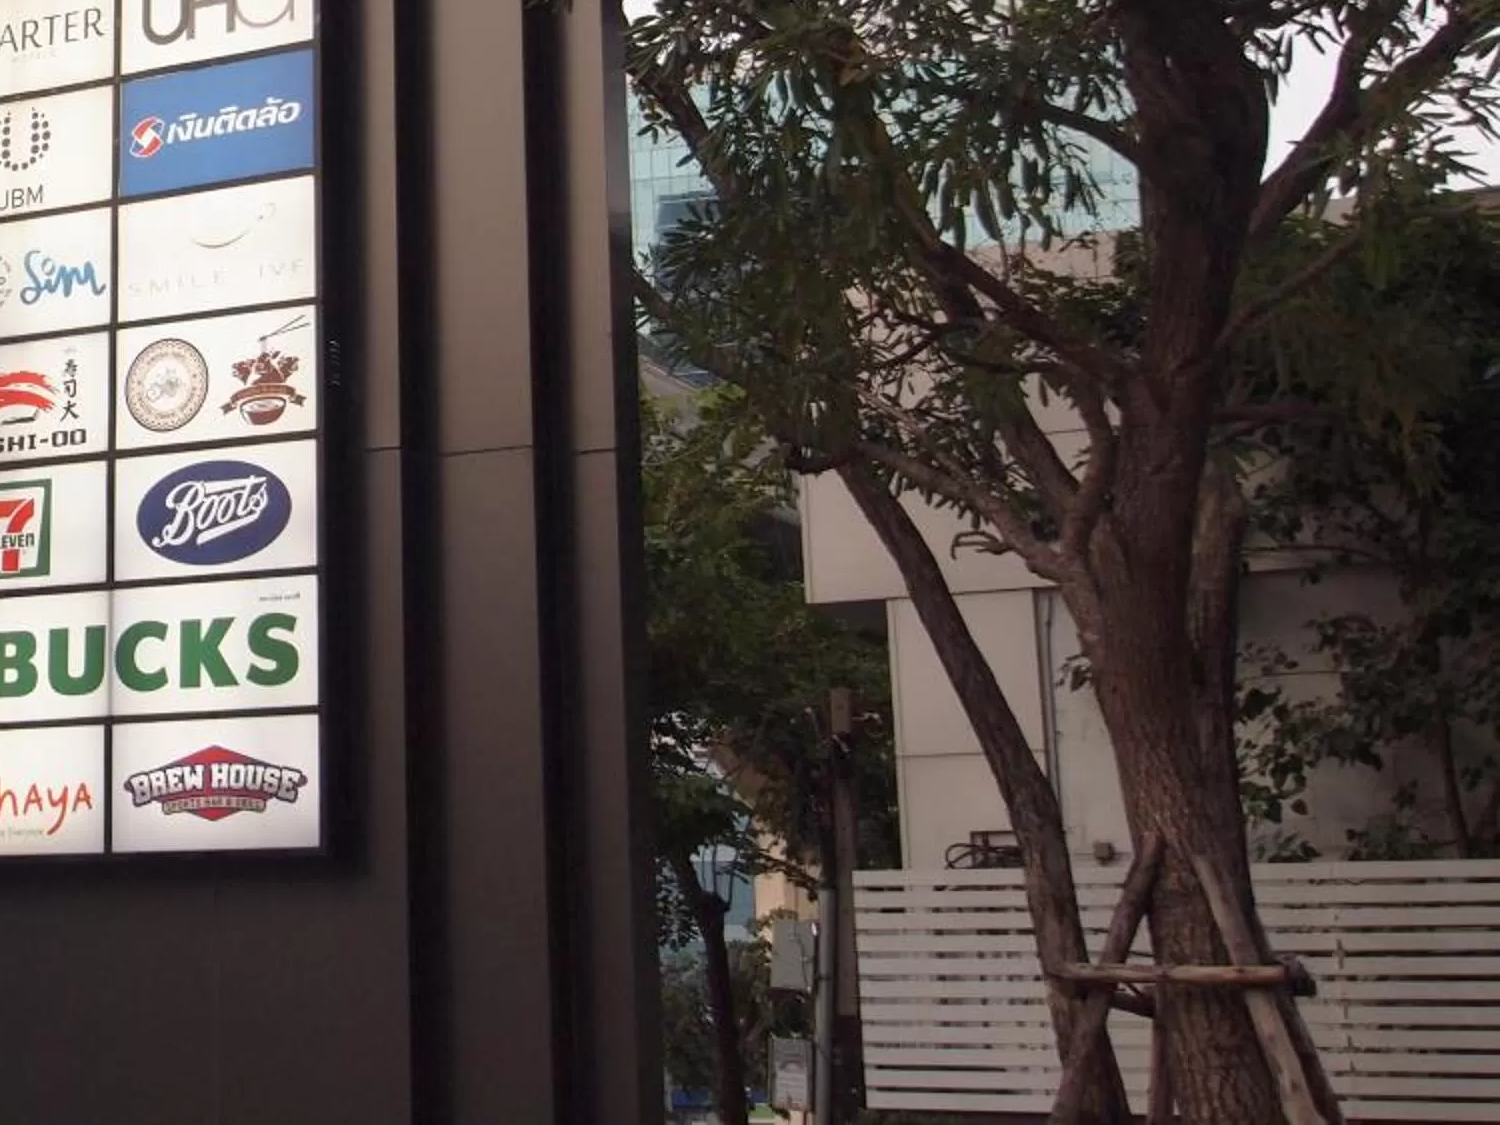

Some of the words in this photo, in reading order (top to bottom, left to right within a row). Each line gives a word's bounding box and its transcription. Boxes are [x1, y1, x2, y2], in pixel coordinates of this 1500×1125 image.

[165, 96, 302, 145] เงินติดล้อ
[128, 269, 229, 297] SMILE
[151, 475, 269, 548] Boots
[128, 763, 205, 804] BREW
[210, 763, 303, 802] HOUSE
